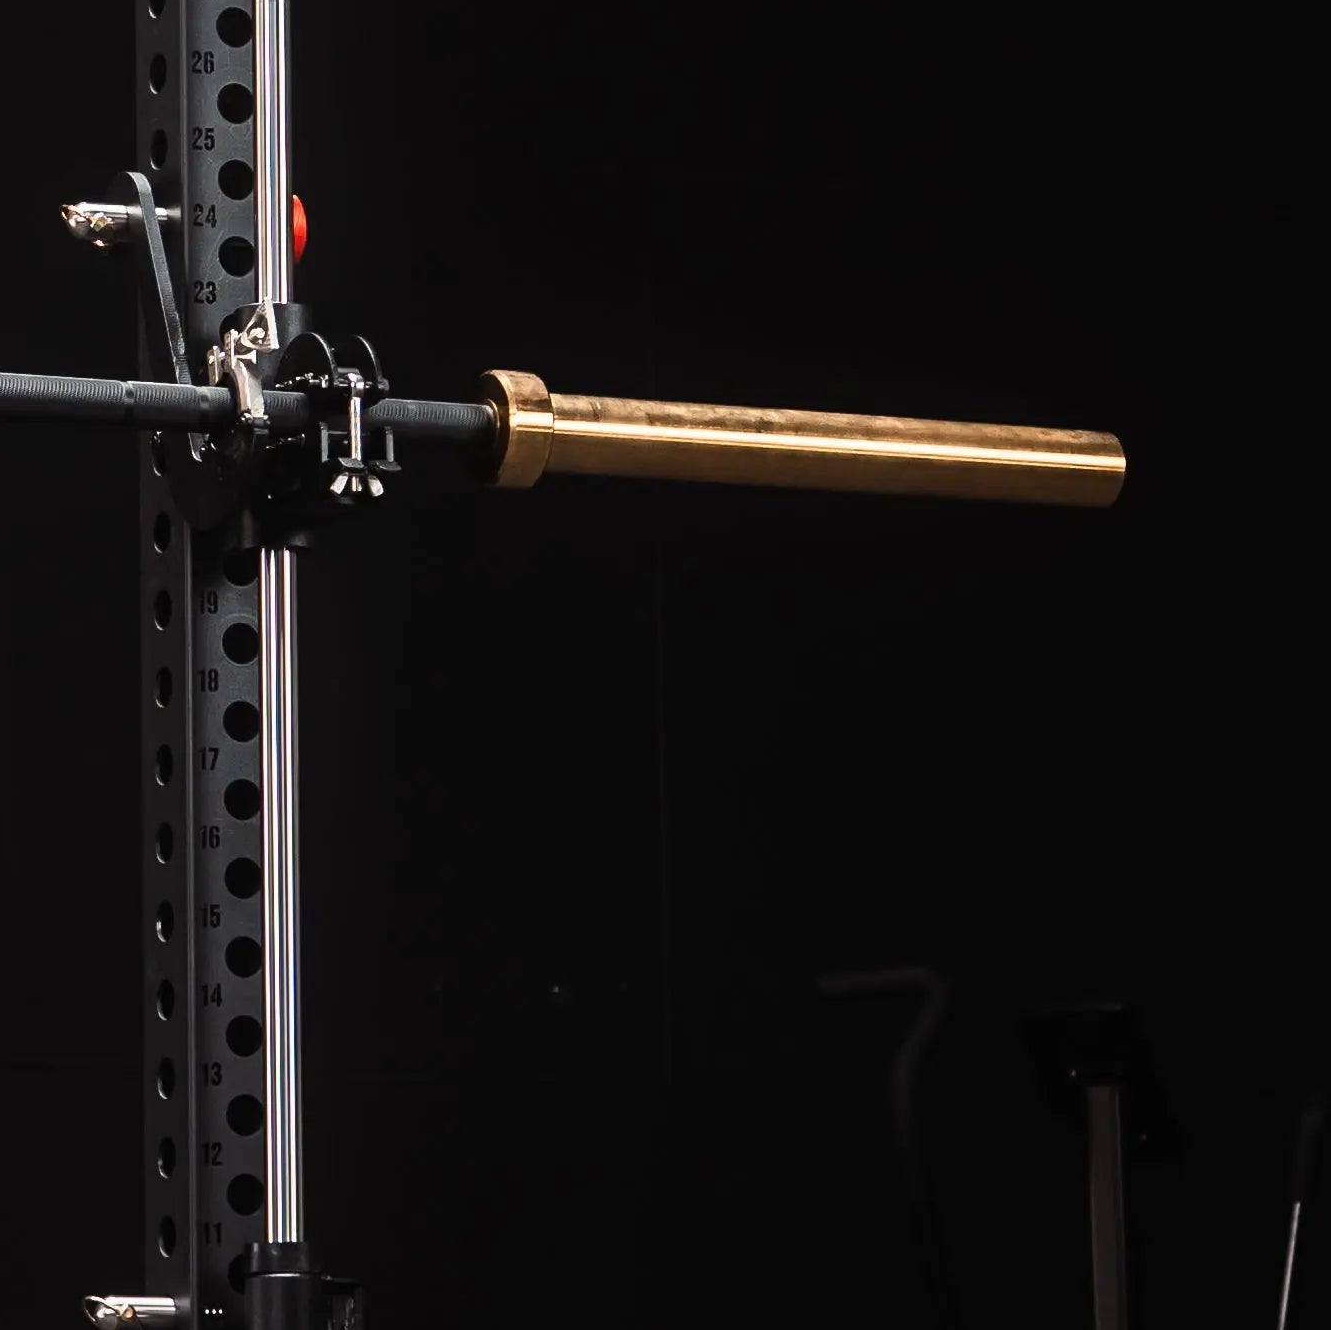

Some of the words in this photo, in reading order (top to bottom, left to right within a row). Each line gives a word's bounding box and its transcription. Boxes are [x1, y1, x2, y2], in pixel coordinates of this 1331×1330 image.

[192, 52, 214, 74] 26
[193, 129, 215, 150] 25
[194, 205, 217, 227] 24
[194, 282, 217, 304] 23
[198, 591, 218, 614] 19
[198, 670, 218, 692] 18
[198, 748, 219, 771] 17
[200, 826, 220, 848] 16
[201, 904, 220, 927] 15
[201, 984, 222, 1007] 14
[202, 1064, 222, 1086] 13
[202, 1143, 222, 1166] 12
[205, 1223, 221, 1246] 11
